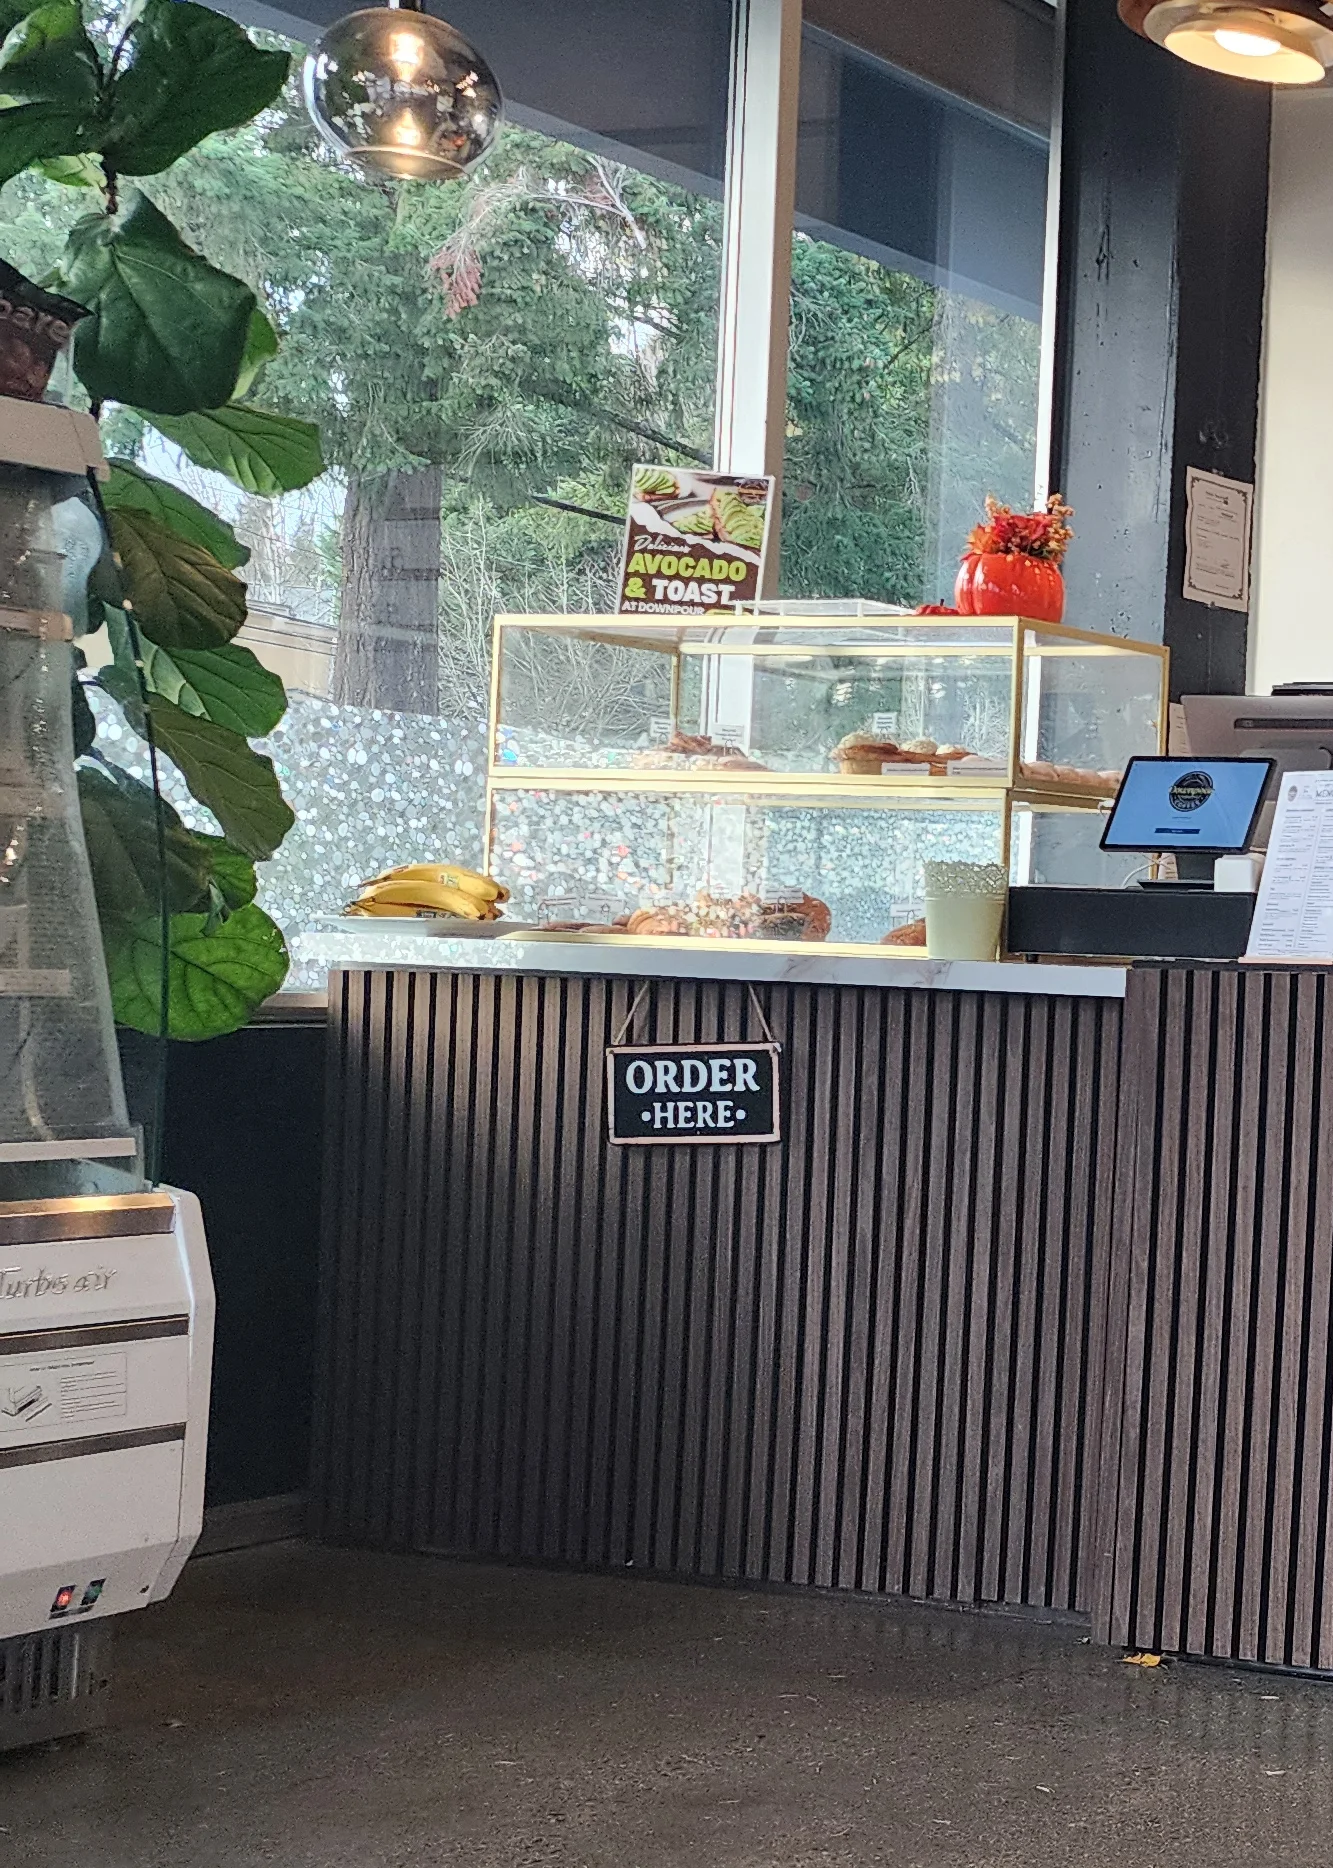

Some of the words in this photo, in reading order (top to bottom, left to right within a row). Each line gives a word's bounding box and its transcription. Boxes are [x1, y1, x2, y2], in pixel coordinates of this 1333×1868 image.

[627, 552, 747, 581] AVOCADO
[625, 577, 647, 598] &
[652, 578, 736, 605] TOAST
[622, 600, 637, 611] AT
[638, 601, 705, 615] DOWNPOUR
[626, 1058, 761, 1094] ORDER
[73, 1264, 118, 1293] air
